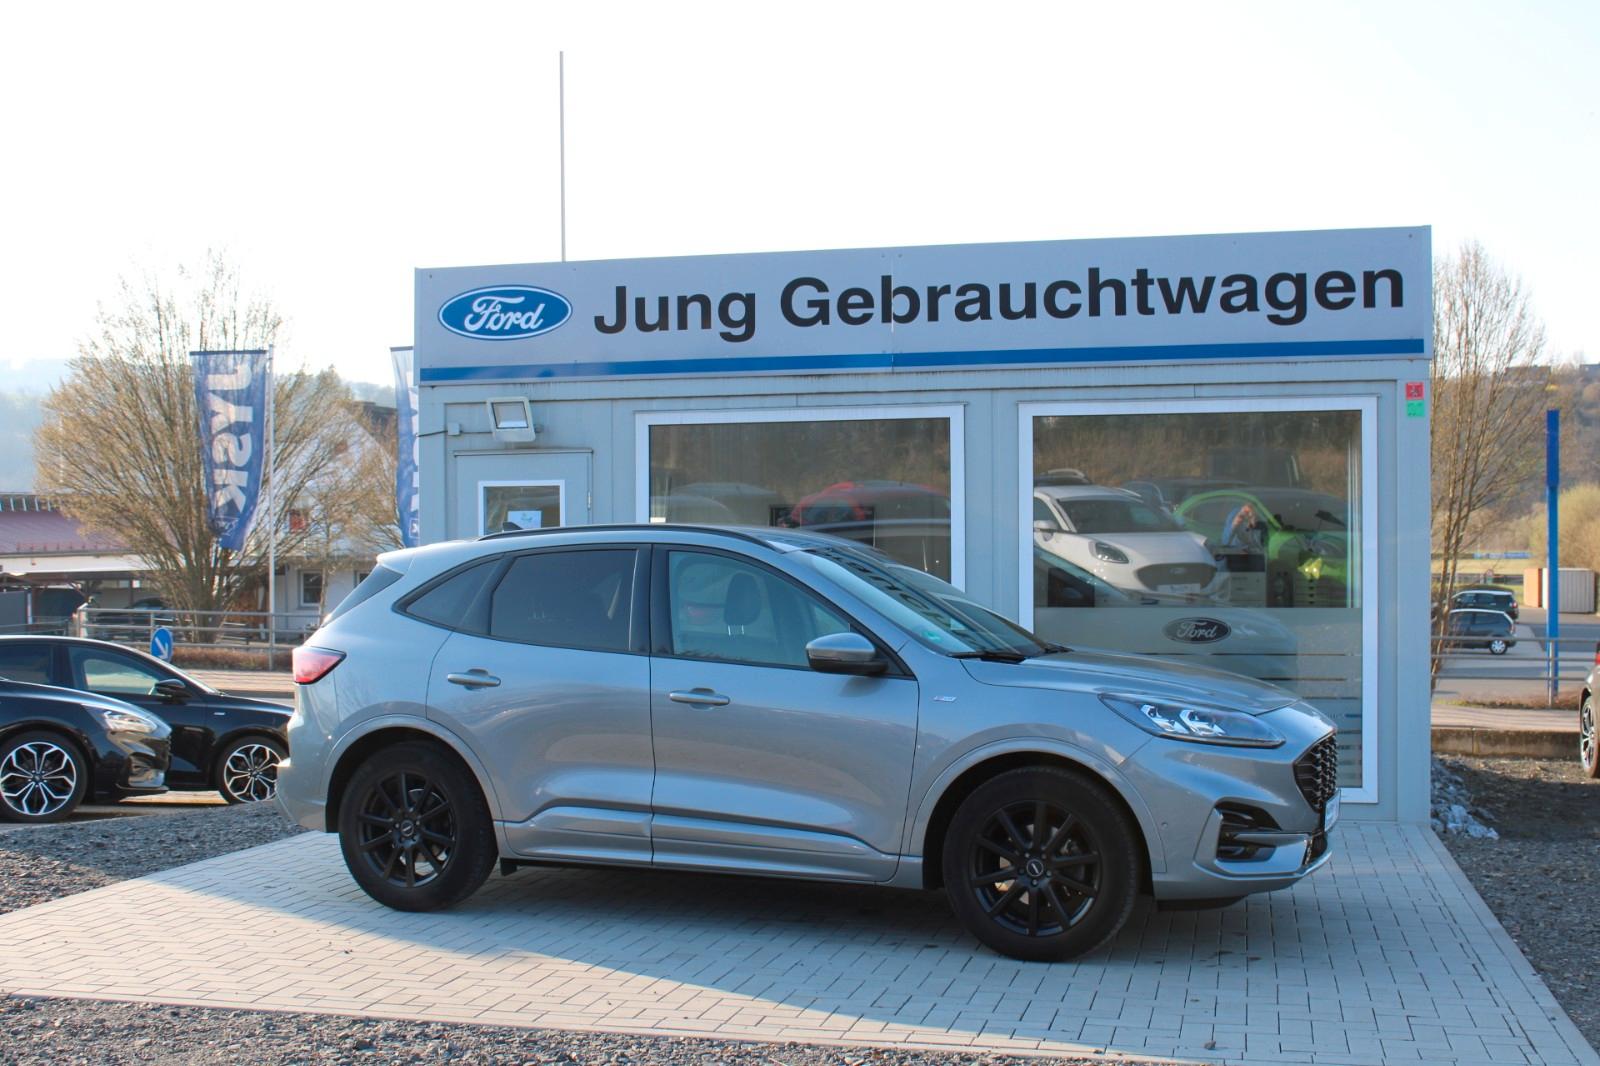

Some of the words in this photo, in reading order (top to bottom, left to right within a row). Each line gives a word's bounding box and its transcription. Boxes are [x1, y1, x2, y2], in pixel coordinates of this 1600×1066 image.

[465, 296, 545, 331] Ford
[595, 287, 755, 342] Jung
[781, 268, 1402, 326] Gebrauchtwagen
[1178, 622, 1216, 638] Ford
